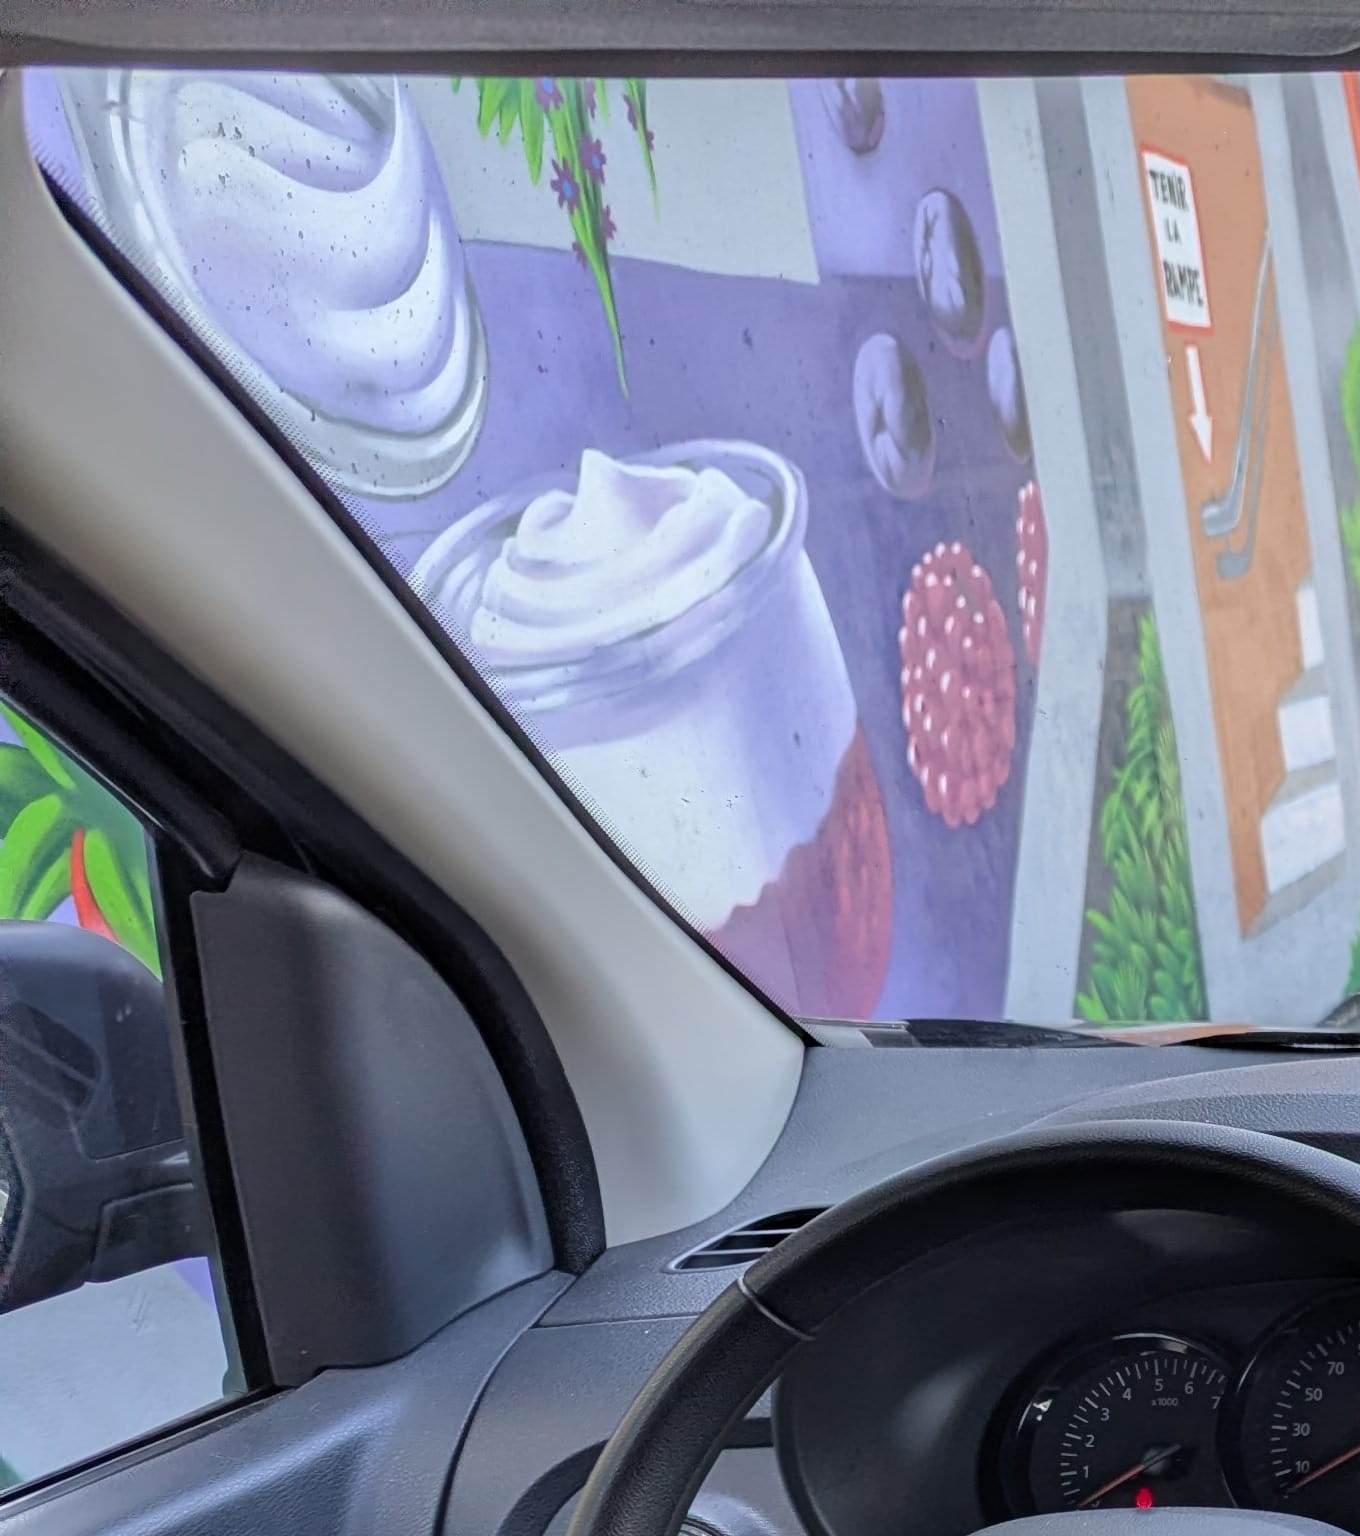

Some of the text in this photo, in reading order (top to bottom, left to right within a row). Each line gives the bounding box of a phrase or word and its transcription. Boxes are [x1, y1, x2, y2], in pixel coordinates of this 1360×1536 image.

[1149, 168, 1190, 213] TENIR
[1165, 217, 1182, 246] LA
[1327, 1361, 1345, 1375] 70
[1154, 1378, 1164, 1392] 5
[1184, 1381, 1194, 1395] 6
[1122, 1387, 1132, 1401] 4
[1304, 1387, 1323, 1401] 50
[1101, 1408, 1110, 1421] 3
[1292, 1422, 1310, 1437] 30
[1085, 1434, 1095, 1448] 2
[1082, 1465, 1090, 1479] 1
[1295, 1460, 1311, 1474] 10
